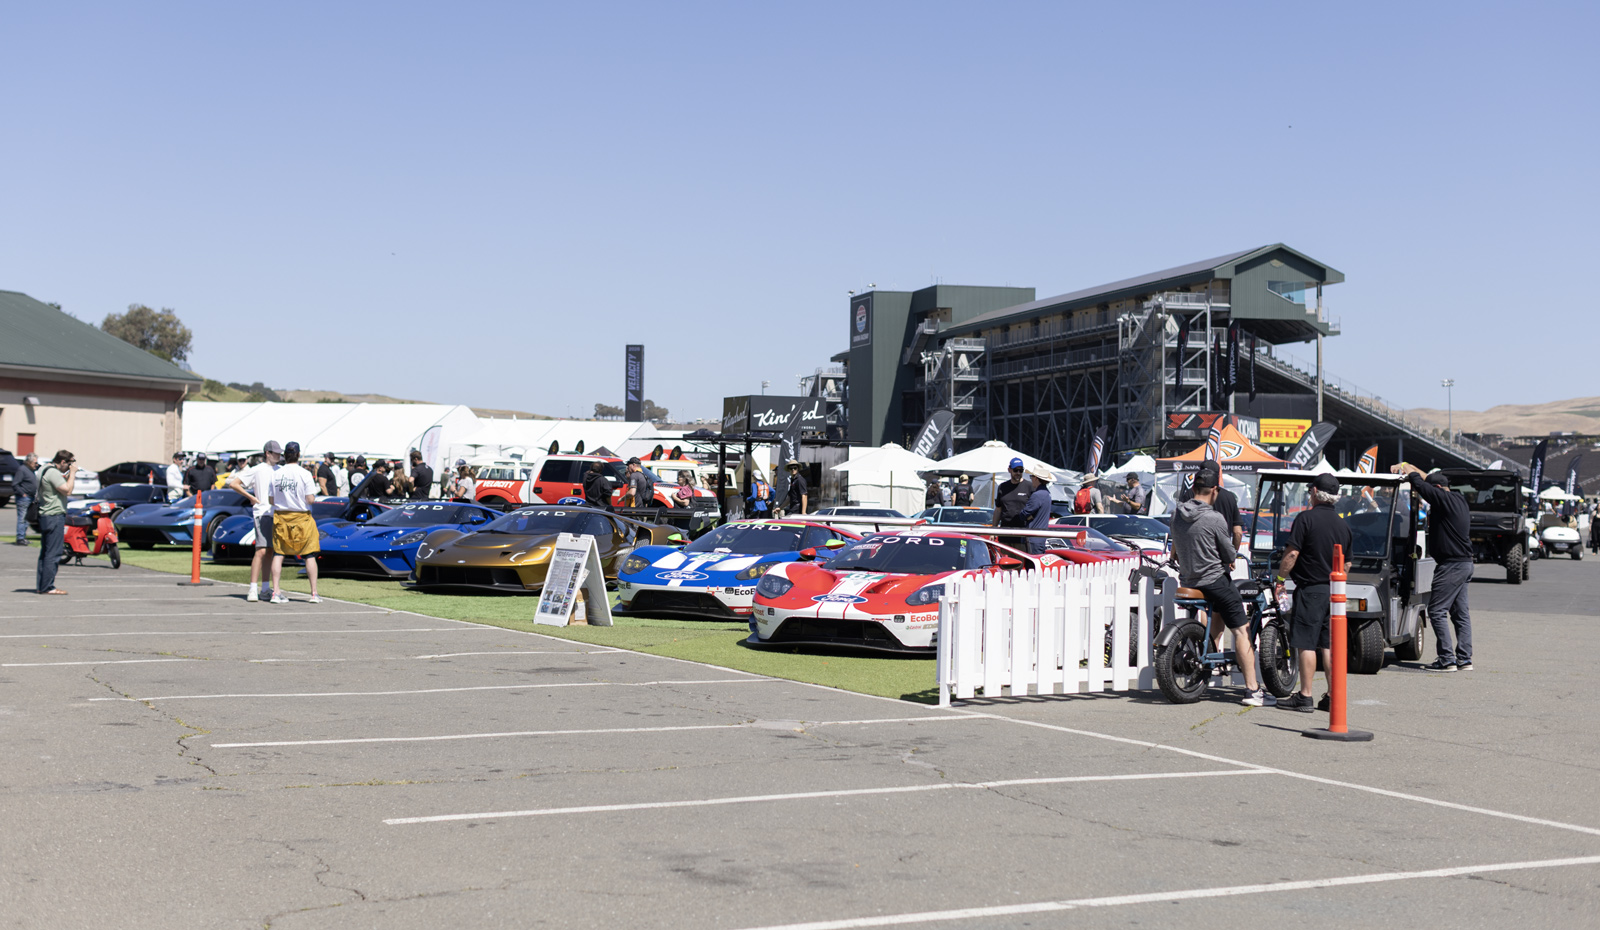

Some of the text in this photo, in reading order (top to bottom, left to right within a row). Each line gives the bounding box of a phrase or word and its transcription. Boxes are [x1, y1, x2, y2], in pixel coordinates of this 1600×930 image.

[628, 353, 637, 390] VELOCITY
[482, 481, 515, 489] VELOCITY
[866, 536, 945, 546] FORD
